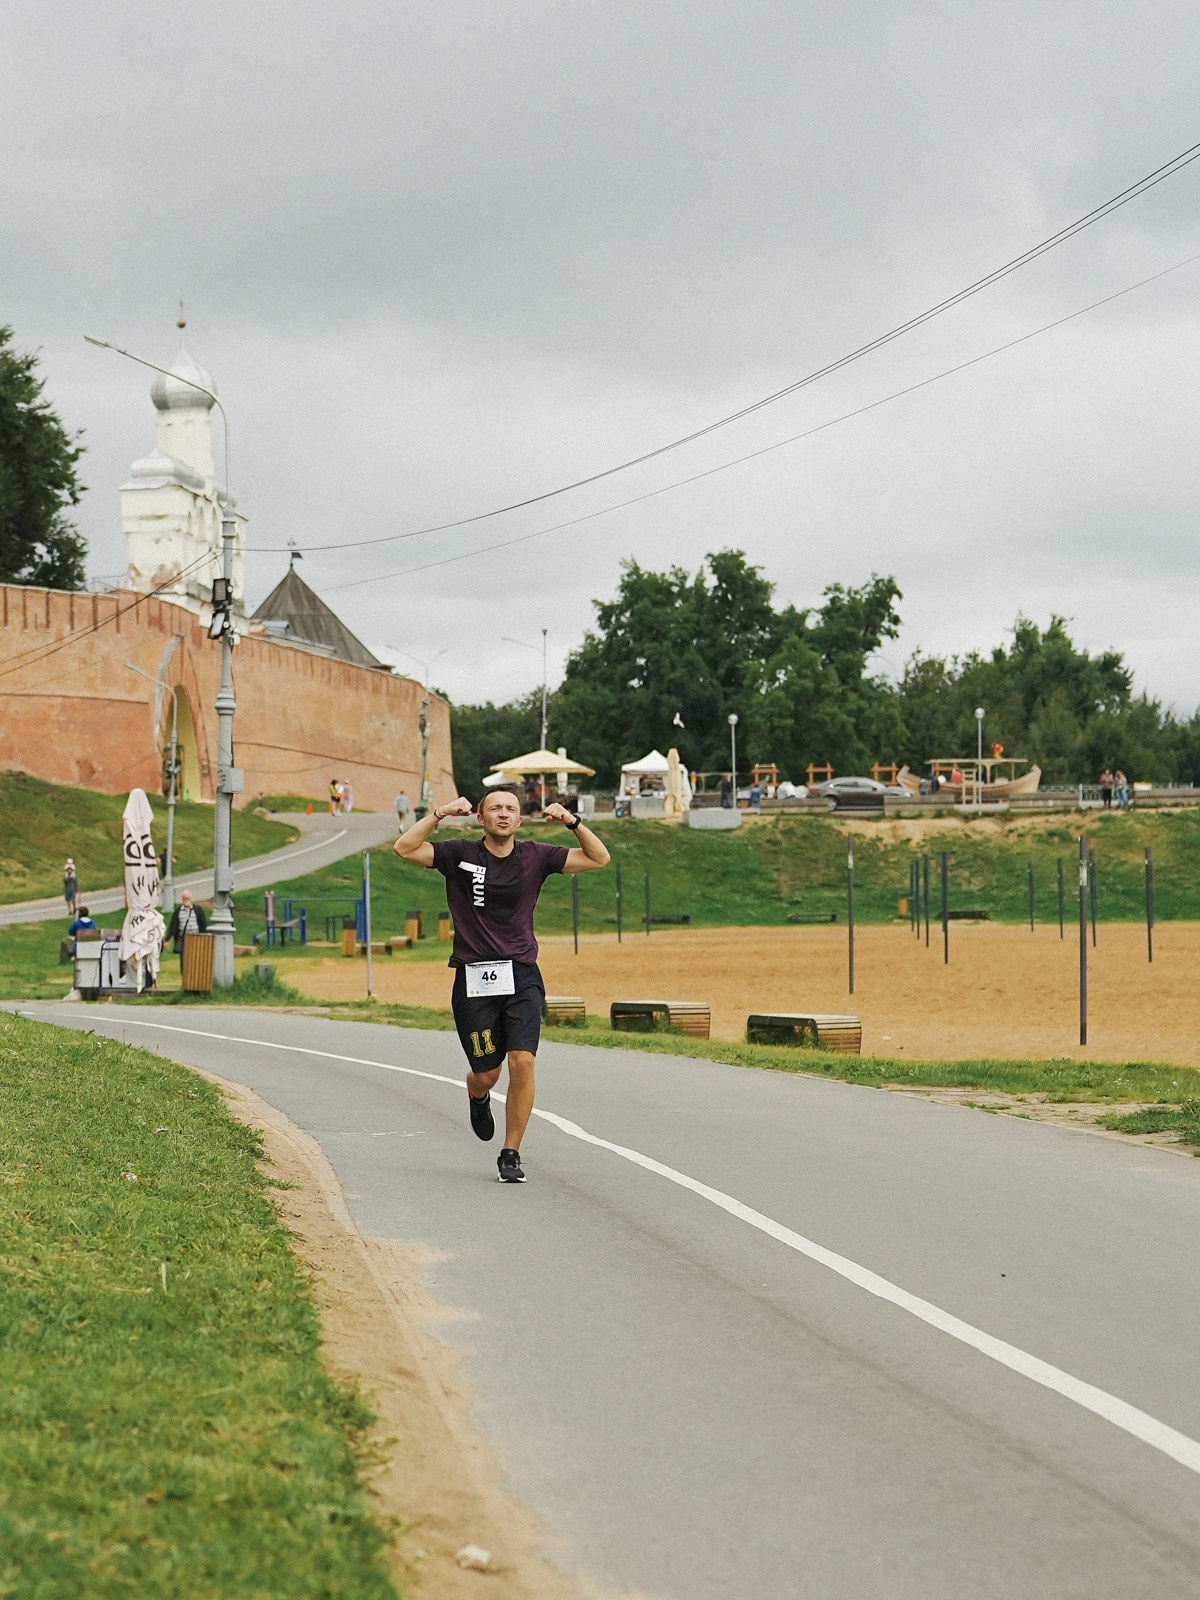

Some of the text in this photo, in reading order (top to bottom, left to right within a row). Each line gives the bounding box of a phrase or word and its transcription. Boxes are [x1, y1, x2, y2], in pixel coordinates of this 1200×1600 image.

[472, 872, 485, 907] RUN
[481, 970, 498, 981] 46
[470, 1029, 496, 1057] 11
